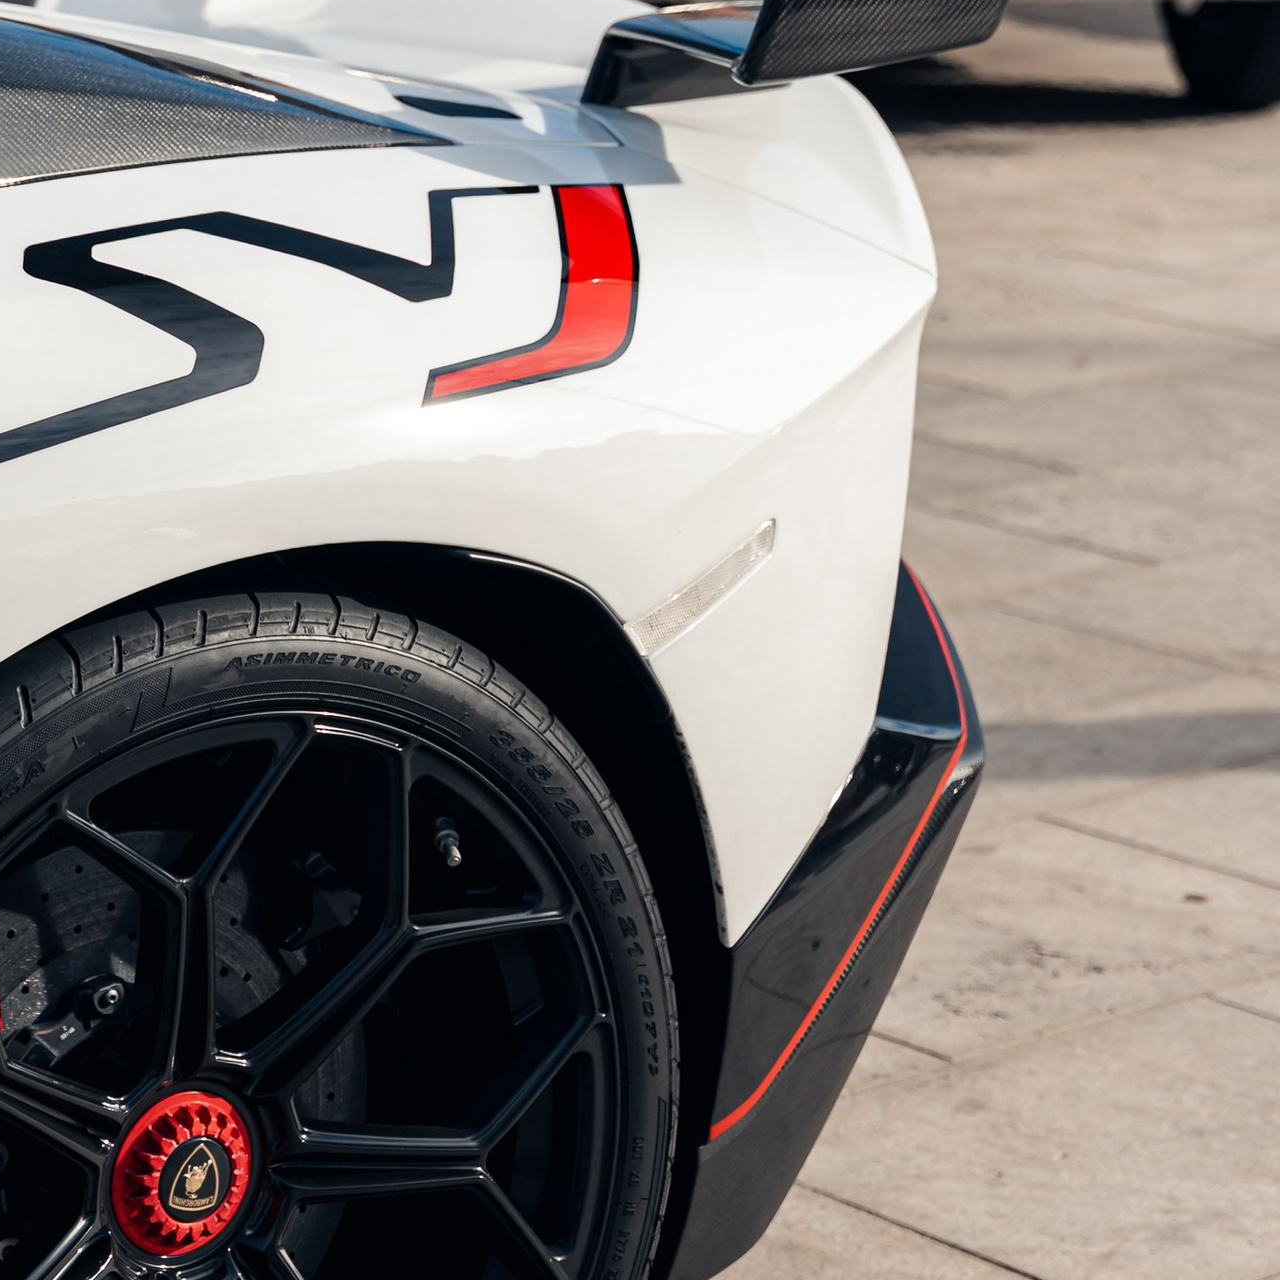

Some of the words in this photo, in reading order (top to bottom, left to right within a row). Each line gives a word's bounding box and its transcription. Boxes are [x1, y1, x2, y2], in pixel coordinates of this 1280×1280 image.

[223, 651, 422, 684] ASIMMETRICO
[489, 727, 594, 840] 355/25
[591, 851, 627, 908] ZR
[619, 913, 646, 963] 21
